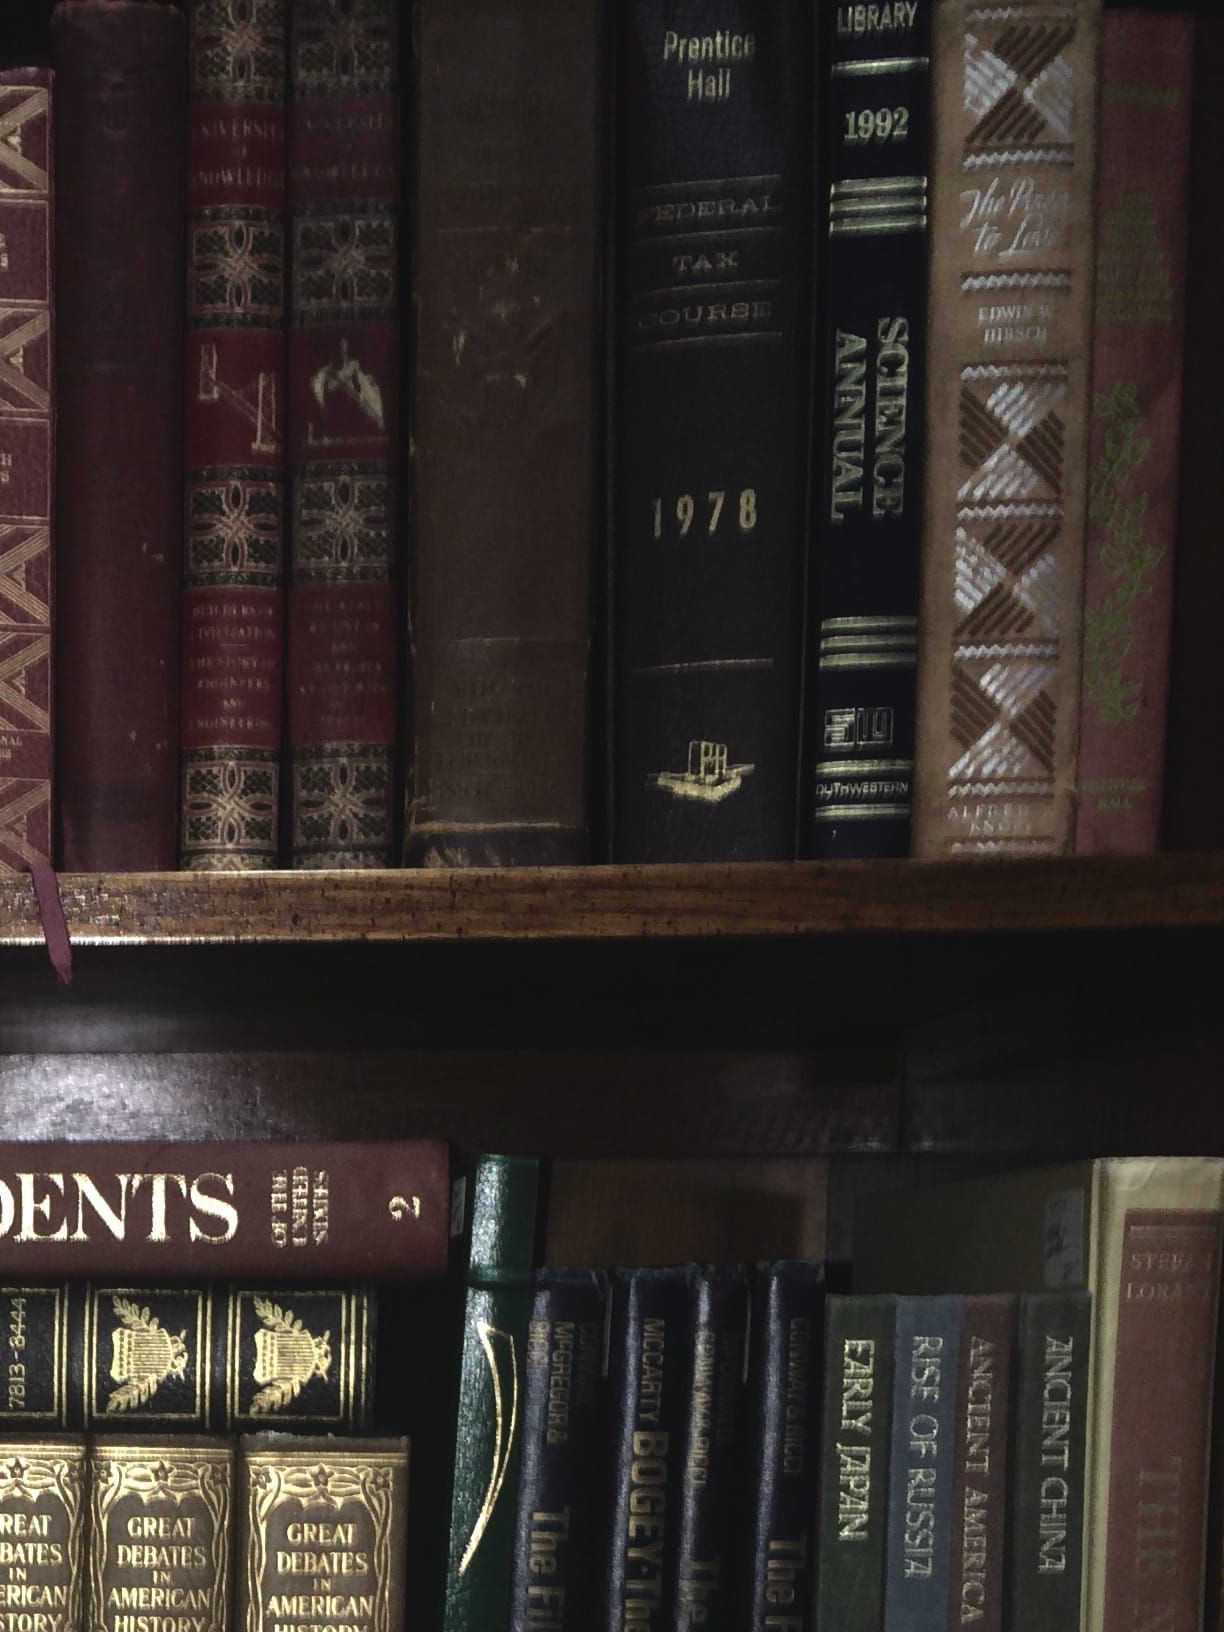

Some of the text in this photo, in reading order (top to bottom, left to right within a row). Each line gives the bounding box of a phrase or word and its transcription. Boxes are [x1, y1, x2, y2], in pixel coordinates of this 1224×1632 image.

[836, 0, 919, 34] LIBRARY
[664, 30, 756, 62] Prentice
[687, 68, 731, 101] Hall
[843, 107, 910, 142] 1992
[673, 251, 739, 273] TAX
[830, 329, 867, 523] ANNUAL
[872, 316, 909, 520] SCIENCE
[651, 488, 758, 538] 1978
[388, 1195, 421, 1222] 2
[837, 1337, 876, 1544] EARLY JAPAN
[904, 1334, 944, 1580] RISE OF RUSSIA
[1037, 1334, 1074, 1576] ANCIENT CHINA
[960, 1334, 994, 1625] ANCIENT AMERICA
[286, 1523, 358, 1544] GREAT
[528, 1505, 571, 1576] The
[8, 1568, 27, 1581] IN
[276, 1551, 368, 1574] DEBATES
[765, 1531, 808, 1605] The
[312, 1578, 331, 1591] IN
[678, 1557, 720, 1624] The
[266, 1595, 373, 1617] AMERICAN
